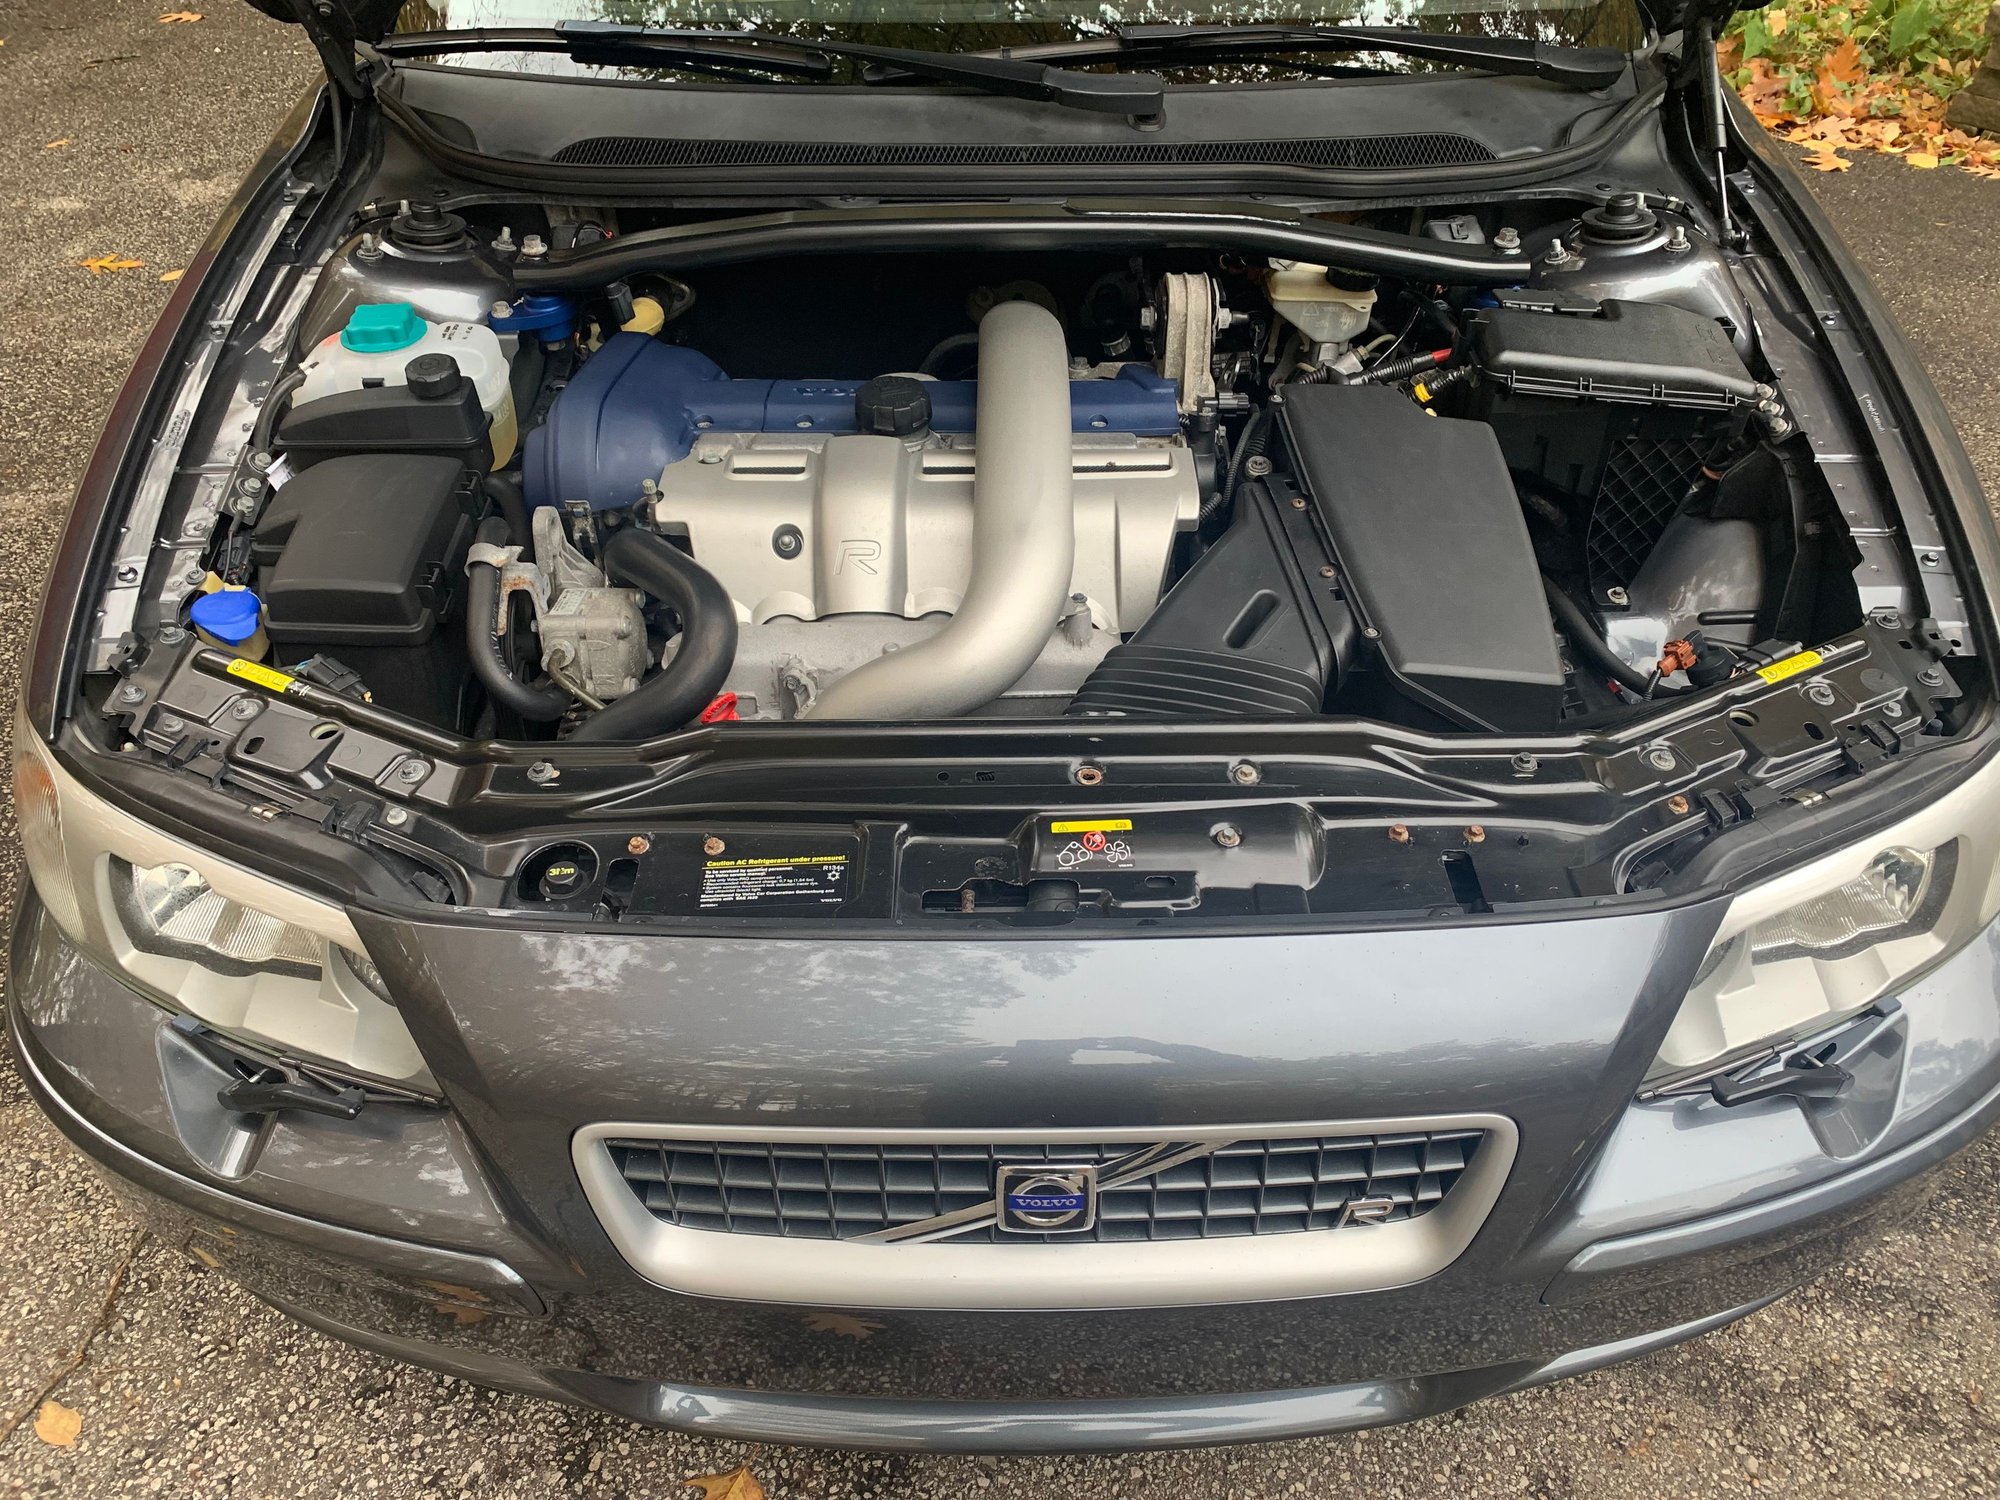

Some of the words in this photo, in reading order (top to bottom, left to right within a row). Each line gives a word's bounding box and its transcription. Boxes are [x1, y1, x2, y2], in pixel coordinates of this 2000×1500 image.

[833, 539, 881, 575] R
[1016, 1198, 1077, 1207] VOLVO
[1336, 1197, 1395, 1229] R
